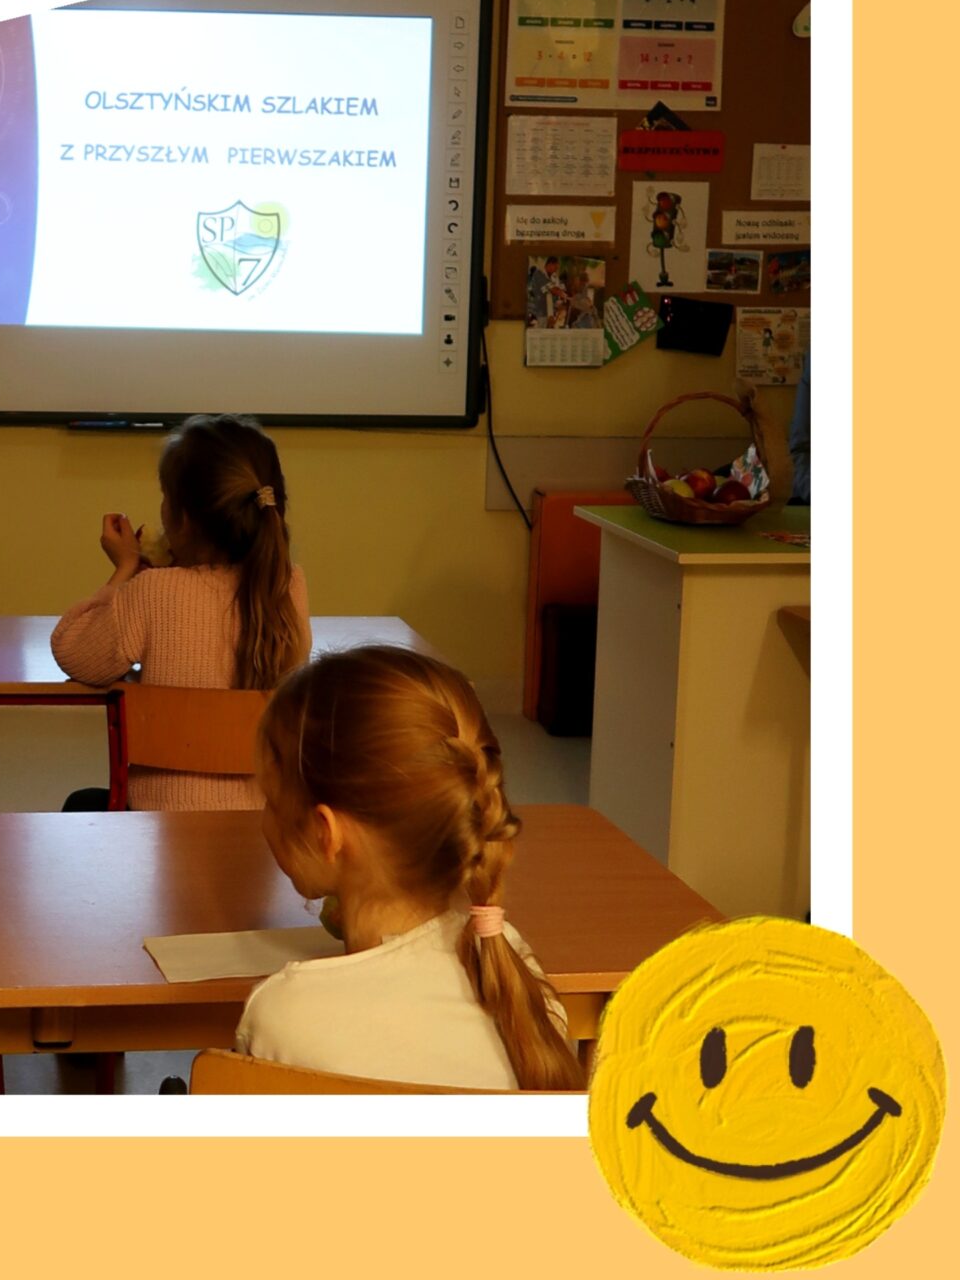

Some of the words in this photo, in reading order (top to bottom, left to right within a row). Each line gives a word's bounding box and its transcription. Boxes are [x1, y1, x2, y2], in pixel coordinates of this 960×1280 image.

[84, 86, 252, 113] OLSZTYŃSKIM
[261, 95, 379, 116] SZLAKIEM
[60, 144, 75, 162] Z
[83, 144, 210, 165] PRZYSZŁYM
[227, 147, 397, 168] PIERWSZAKIEM
[200, 214, 236, 244] SP
[237, 258, 262, 287] 7
